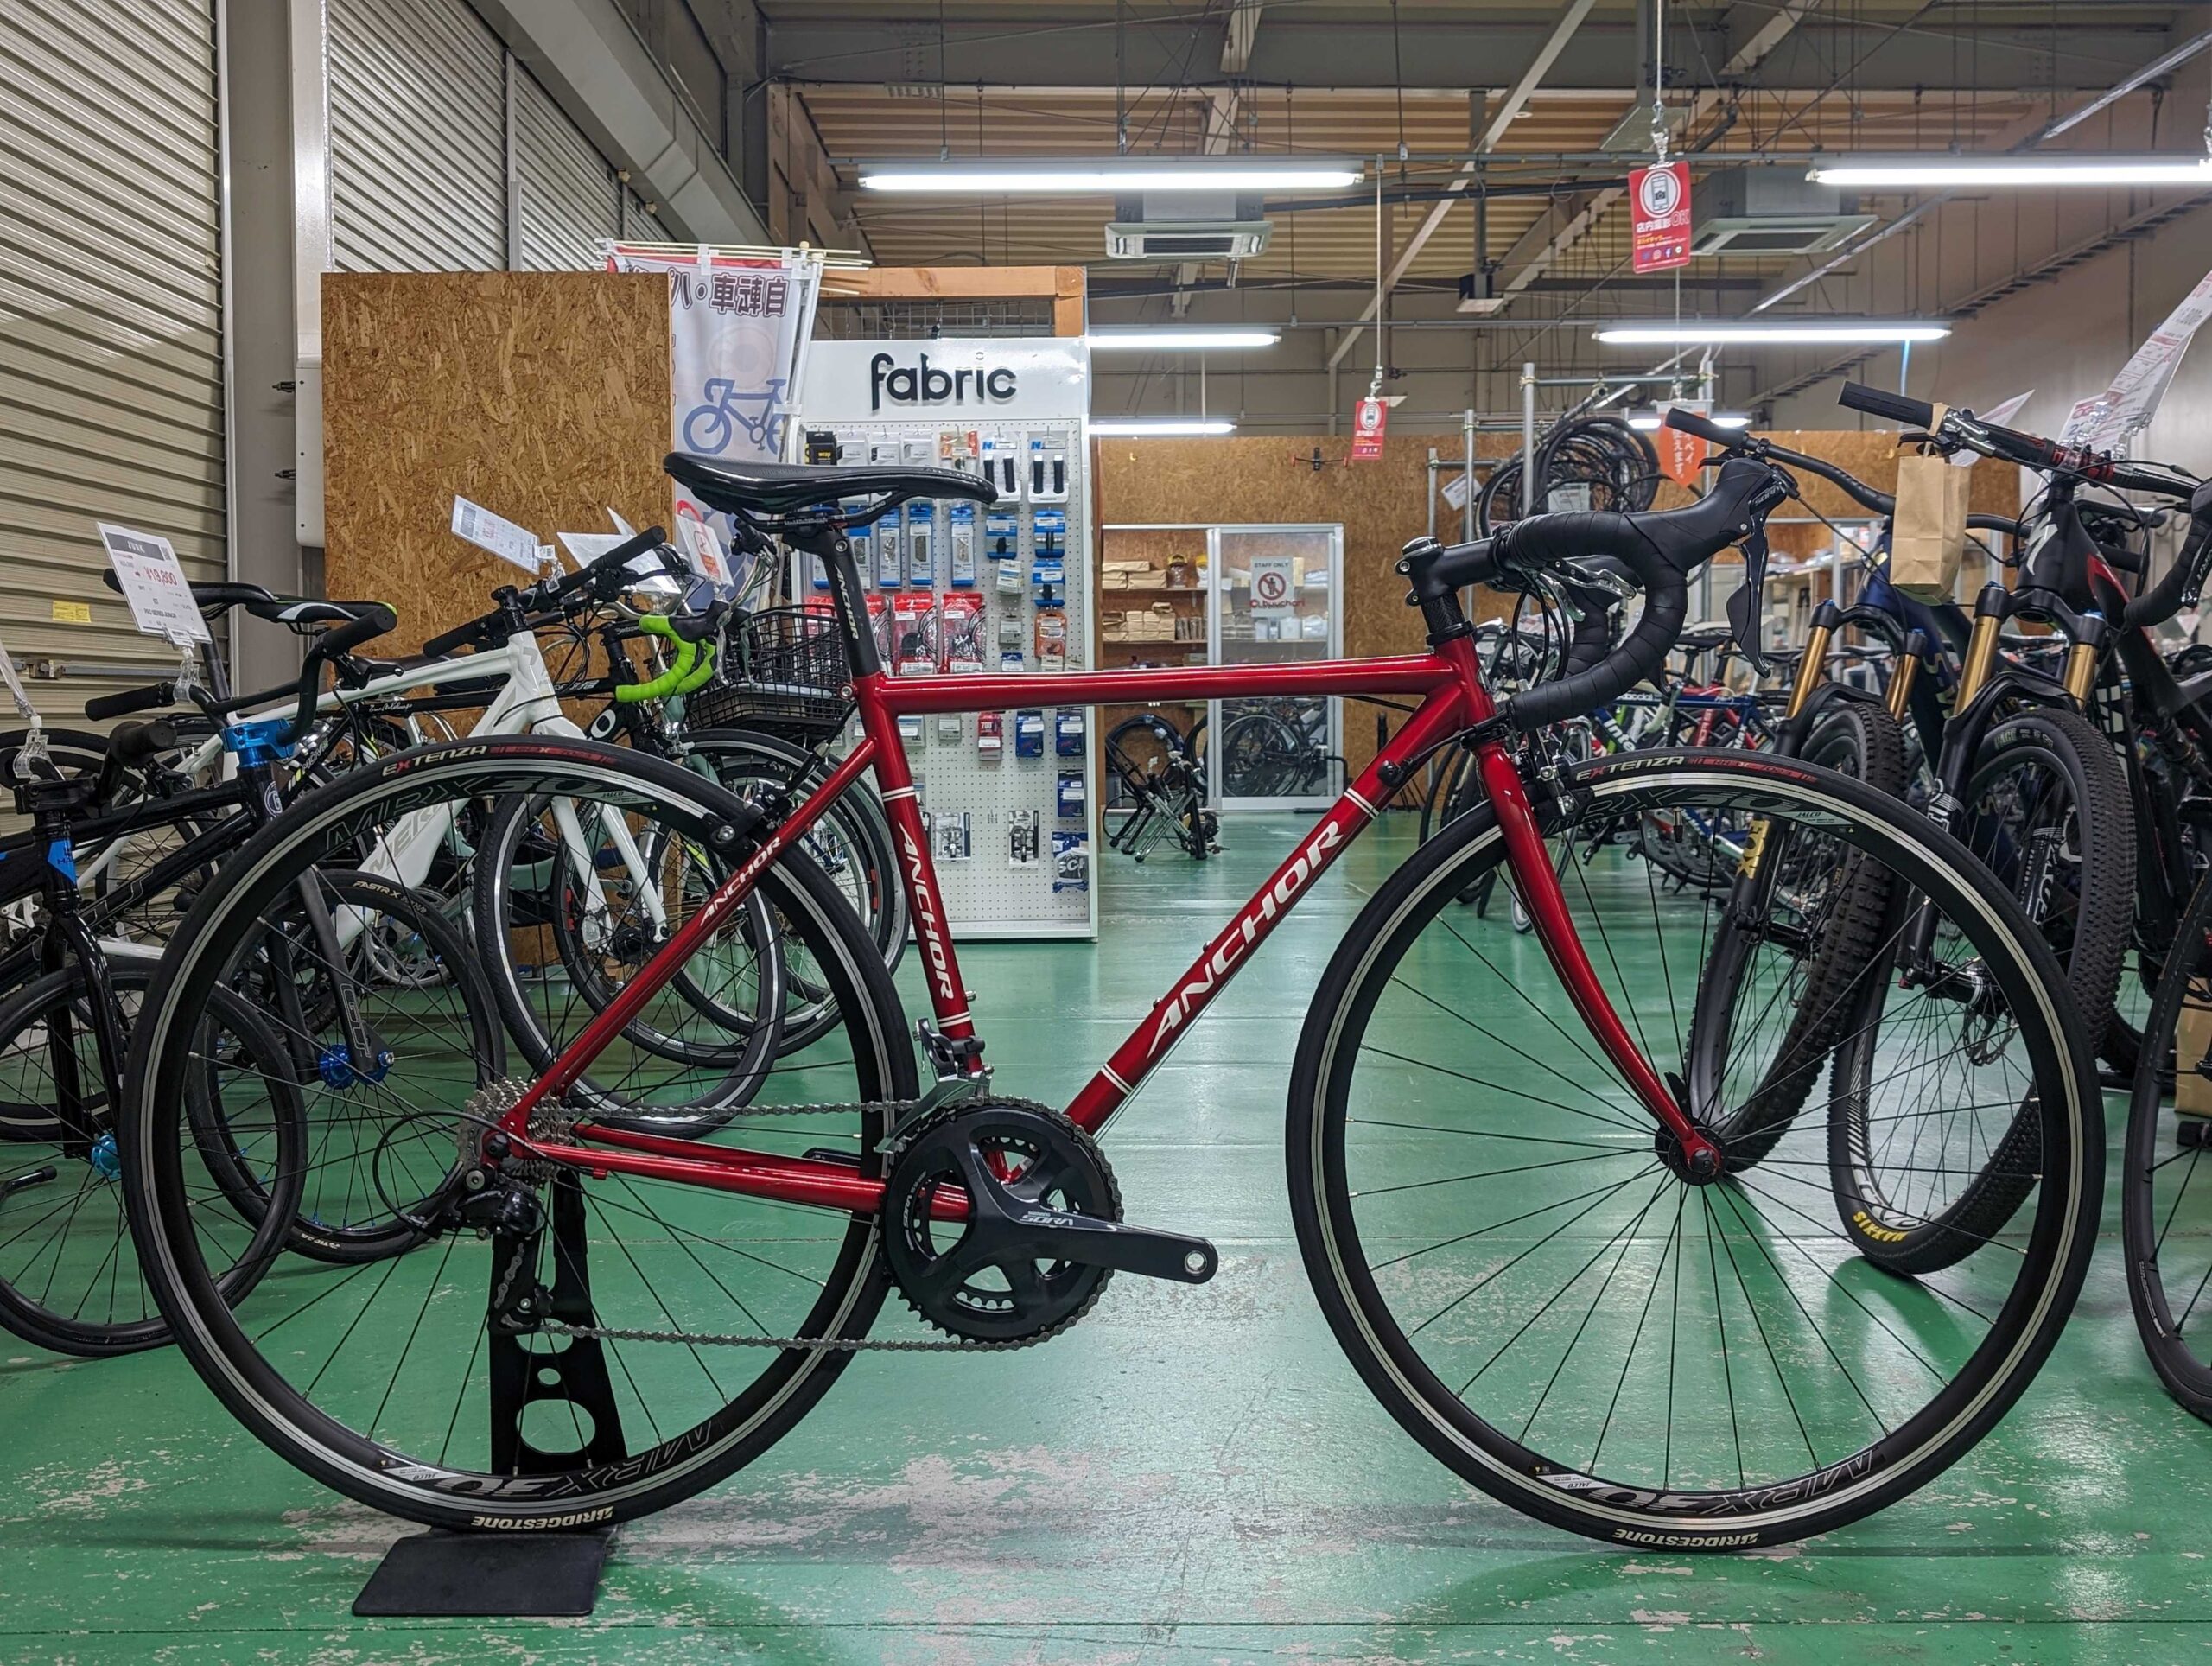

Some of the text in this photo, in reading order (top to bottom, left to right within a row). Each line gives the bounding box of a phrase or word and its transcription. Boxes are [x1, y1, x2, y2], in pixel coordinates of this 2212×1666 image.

[871, 353, 1017, 410] fabric
[835, 563, 859, 639] ANCHOR
[382, 745, 487, 777] EXTENZA
[1576, 756, 1685, 781] EXTENZA
[700, 836, 781, 926] ANCHOR
[899, 821, 955, 1001] ANCHOR
[1147, 820, 1344, 1059] ANCHOR
[1020, 1214, 1074, 1226] SORA
[1853, 1211, 1909, 1243] MAXXIS
[472, 1506, 614, 1529] BRIDGESTONE
[1611, 1528, 1760, 1548] BRIDGESTONE
